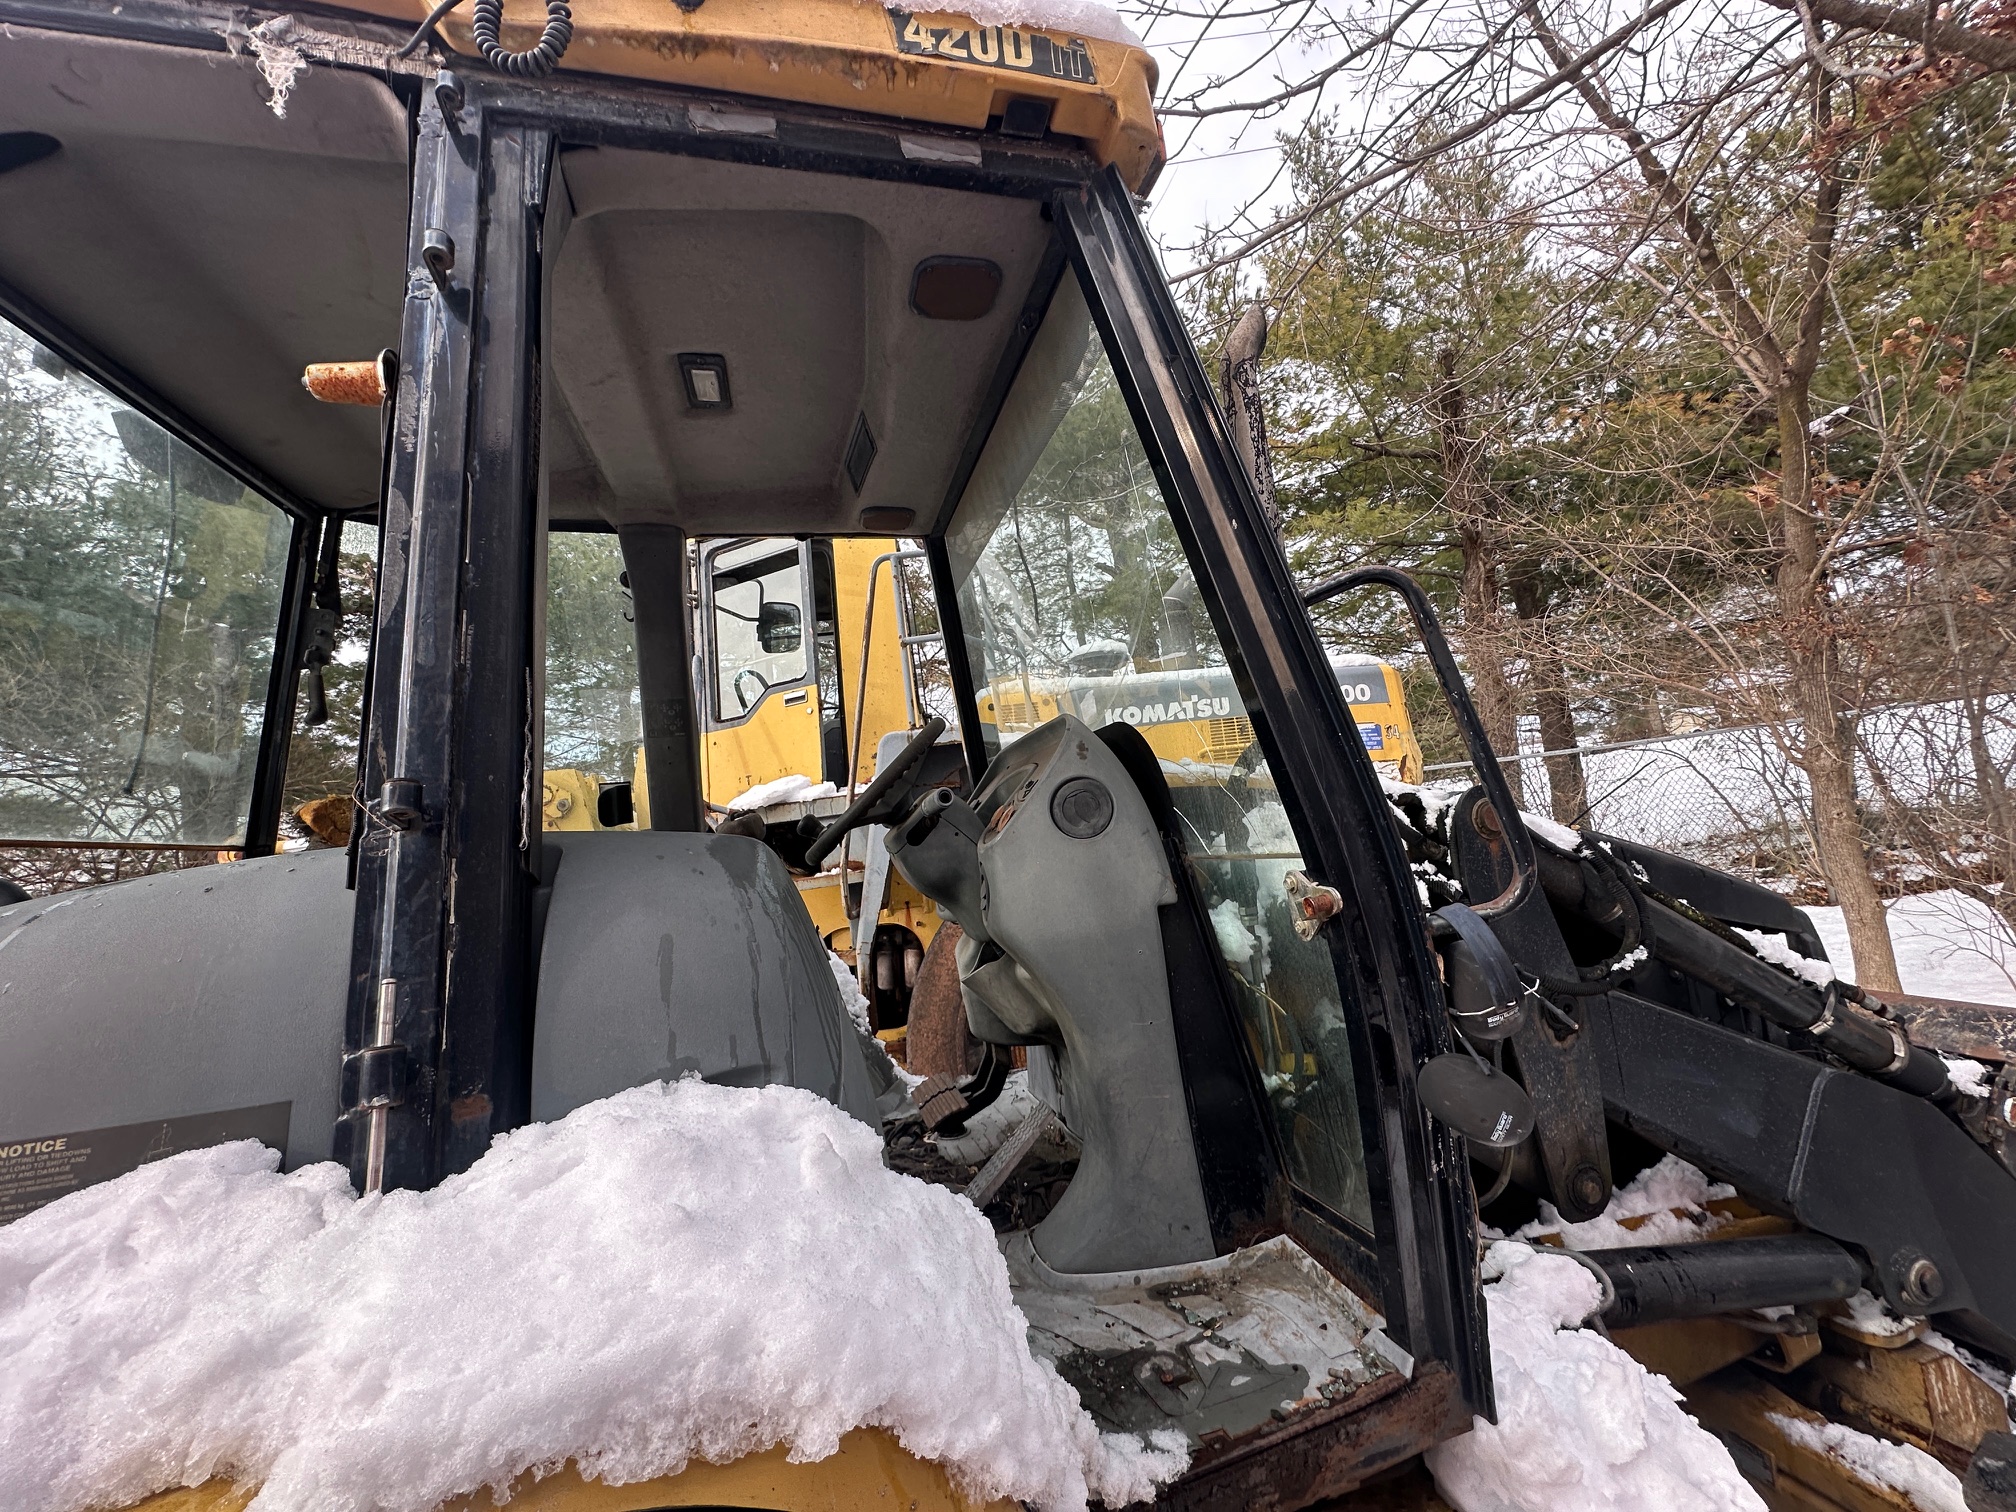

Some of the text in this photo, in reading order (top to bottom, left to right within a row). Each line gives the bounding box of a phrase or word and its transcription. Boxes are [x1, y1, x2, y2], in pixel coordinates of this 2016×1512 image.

[1104, 694, 1230, 726] KOMATSU
[0, 1138, 67, 1158] NOTICE
[10, 1164, 32, 1172] LOAD
[18, 1170, 35, 1178] AND
[37, 1164, 71, 1176] DAMAGE
